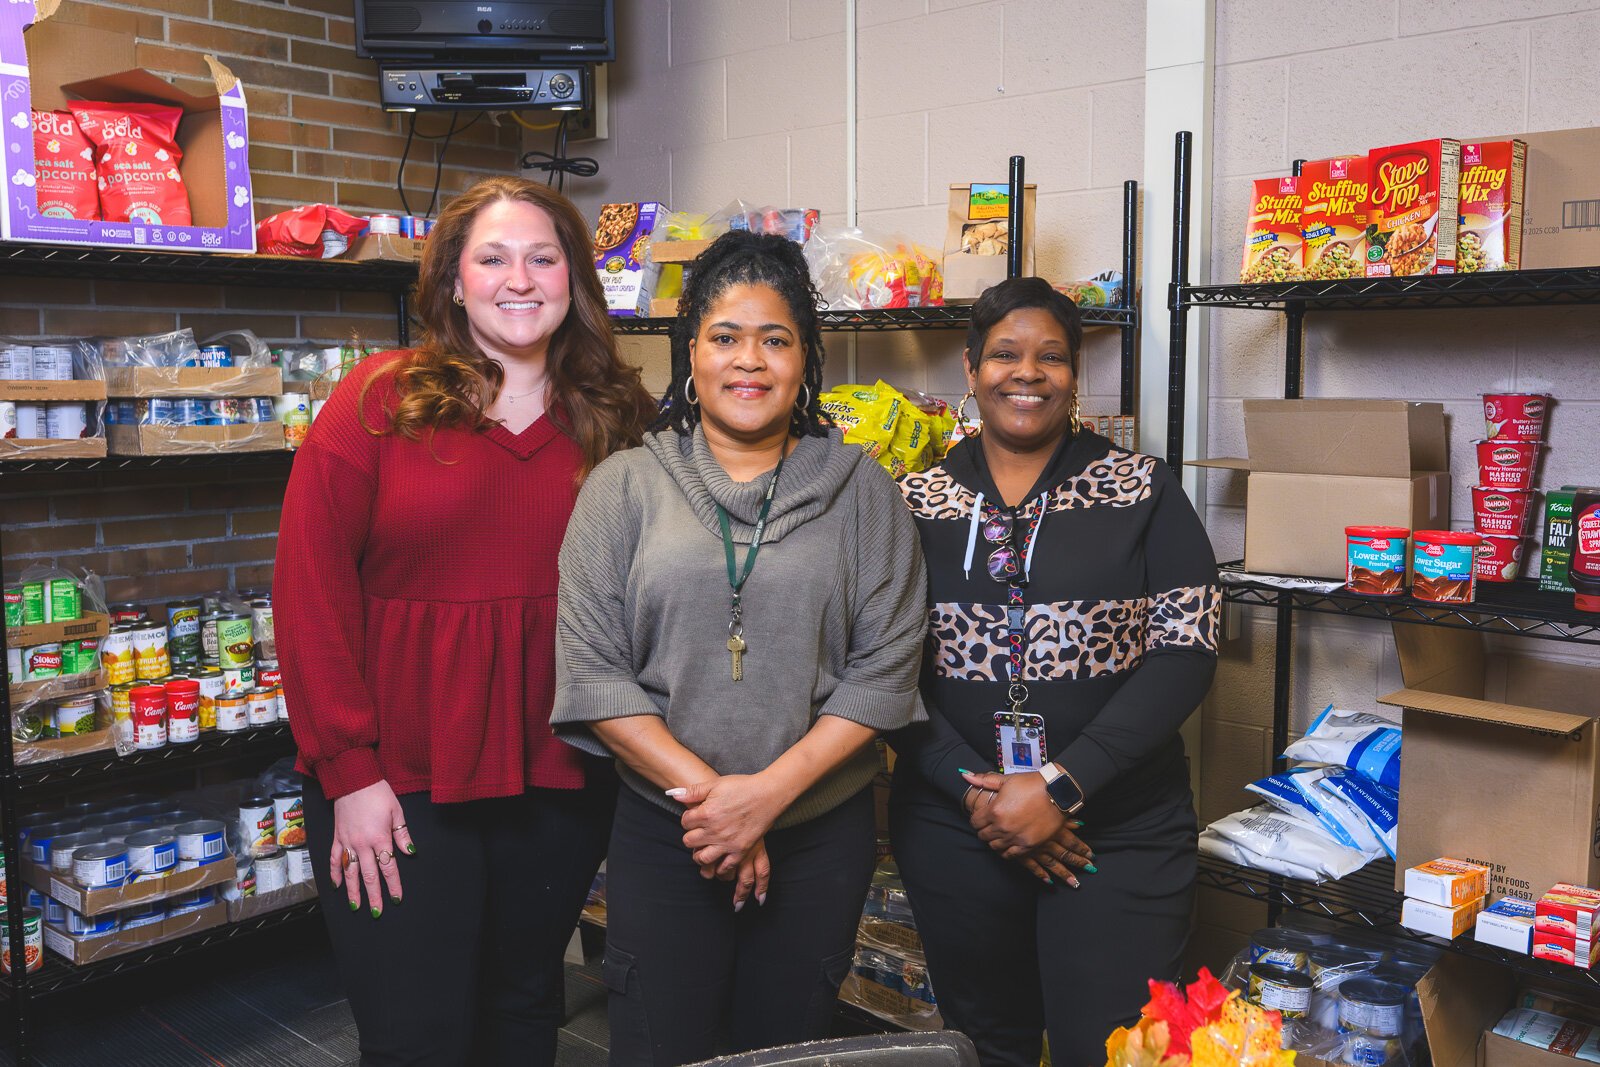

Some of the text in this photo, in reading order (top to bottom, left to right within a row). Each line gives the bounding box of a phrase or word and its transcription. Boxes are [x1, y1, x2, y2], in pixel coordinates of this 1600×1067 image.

[102, 119, 144, 140] bold
[53, 159, 75, 169] salt
[113, 161, 152, 171] sea salt
[107, 170, 166, 188] popcorn
[1371, 157, 1430, 205] Stove
[1307, 179, 1369, 203] Stuffing
[1389, 183, 1420, 213] Top
[1458, 183, 1492, 204] Mix
[1326, 197, 1357, 217] Mix
[1270, 208, 1302, 225] Mix
[1386, 211, 1421, 230] CHICKEN
[101, 229, 116, 238] NO
[1528, 228, 1543, 236] 2025
[1544, 226, 1560, 235] CC80
[1493, 453, 1519, 461] IDAHOAN
[1501, 465, 1527, 473] Homestyle
[1548, 536, 1566, 548] MIX
[1353, 550, 1404, 563] Lower Sugar
[1414, 554, 1463, 572] Lower Sugar
[1423, 566, 1444, 575] Frosting
[1344, 778, 1394, 822] BASIC AMERICAN FOODS
[1496, 864, 1507, 874] BY
[1505, 877, 1530, 890] FOODS
[1496, 885, 1533, 901] CA 94597
